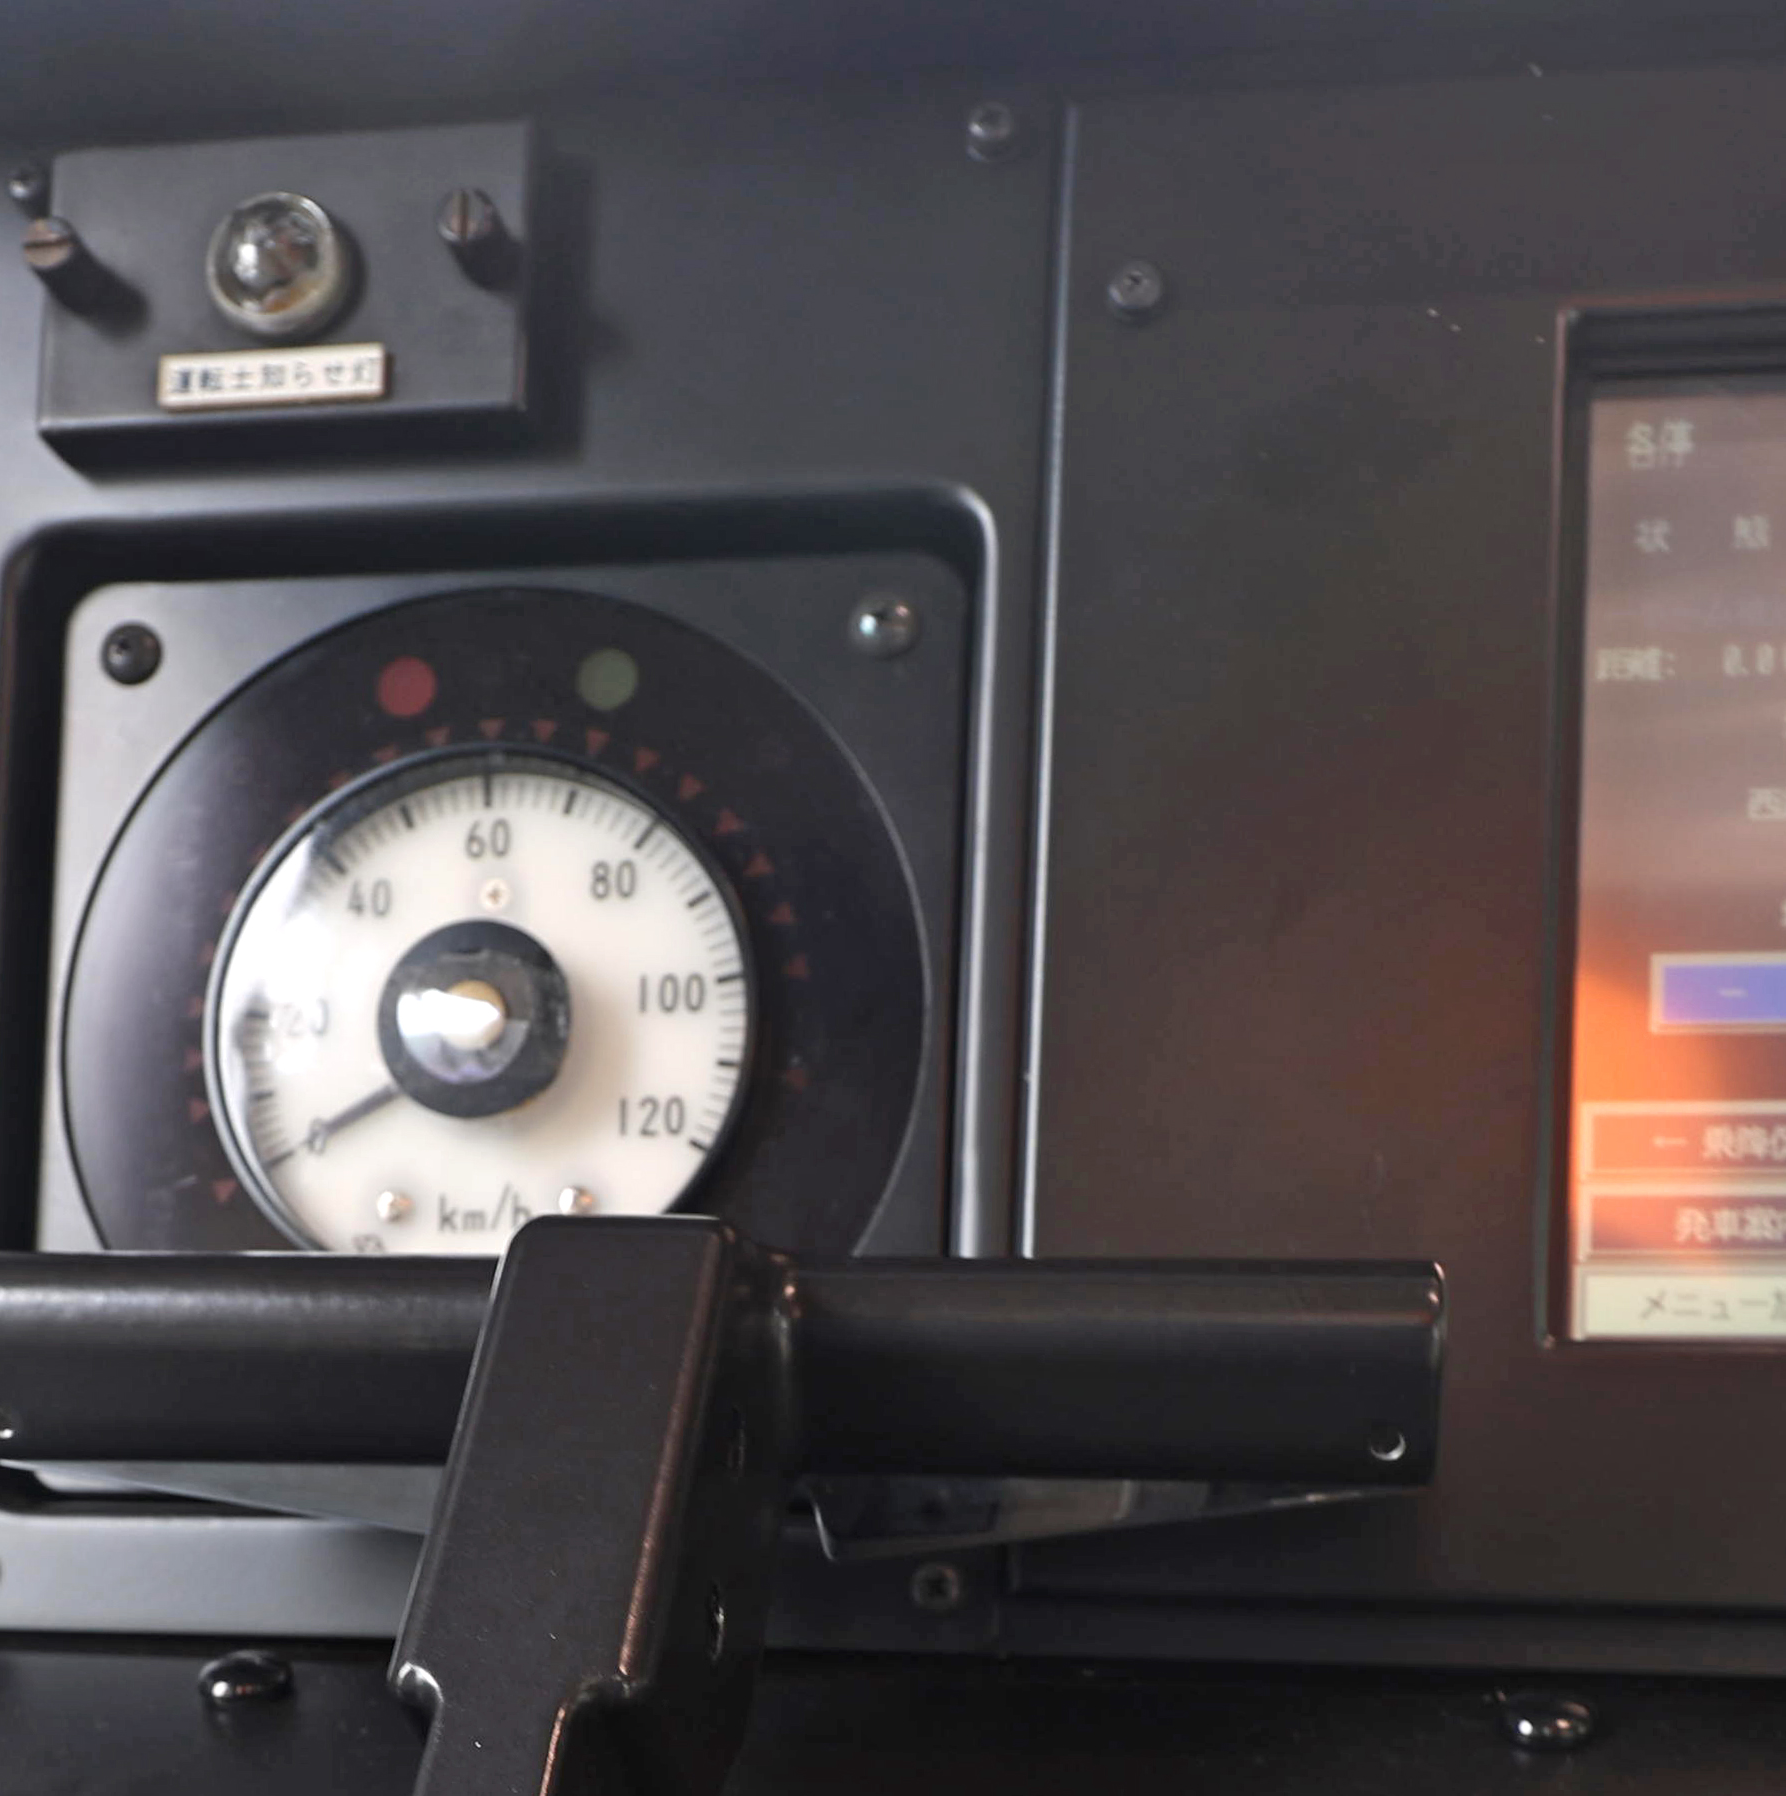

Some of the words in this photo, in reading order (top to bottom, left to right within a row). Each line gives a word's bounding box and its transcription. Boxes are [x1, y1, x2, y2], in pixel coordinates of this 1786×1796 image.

[465, 820, 512, 859] 60
[346, 879, 393, 918] 40
[590, 860, 637, 900] 80
[636, 974, 706, 1015] 100
[617, 1097, 686, 1138] 120
